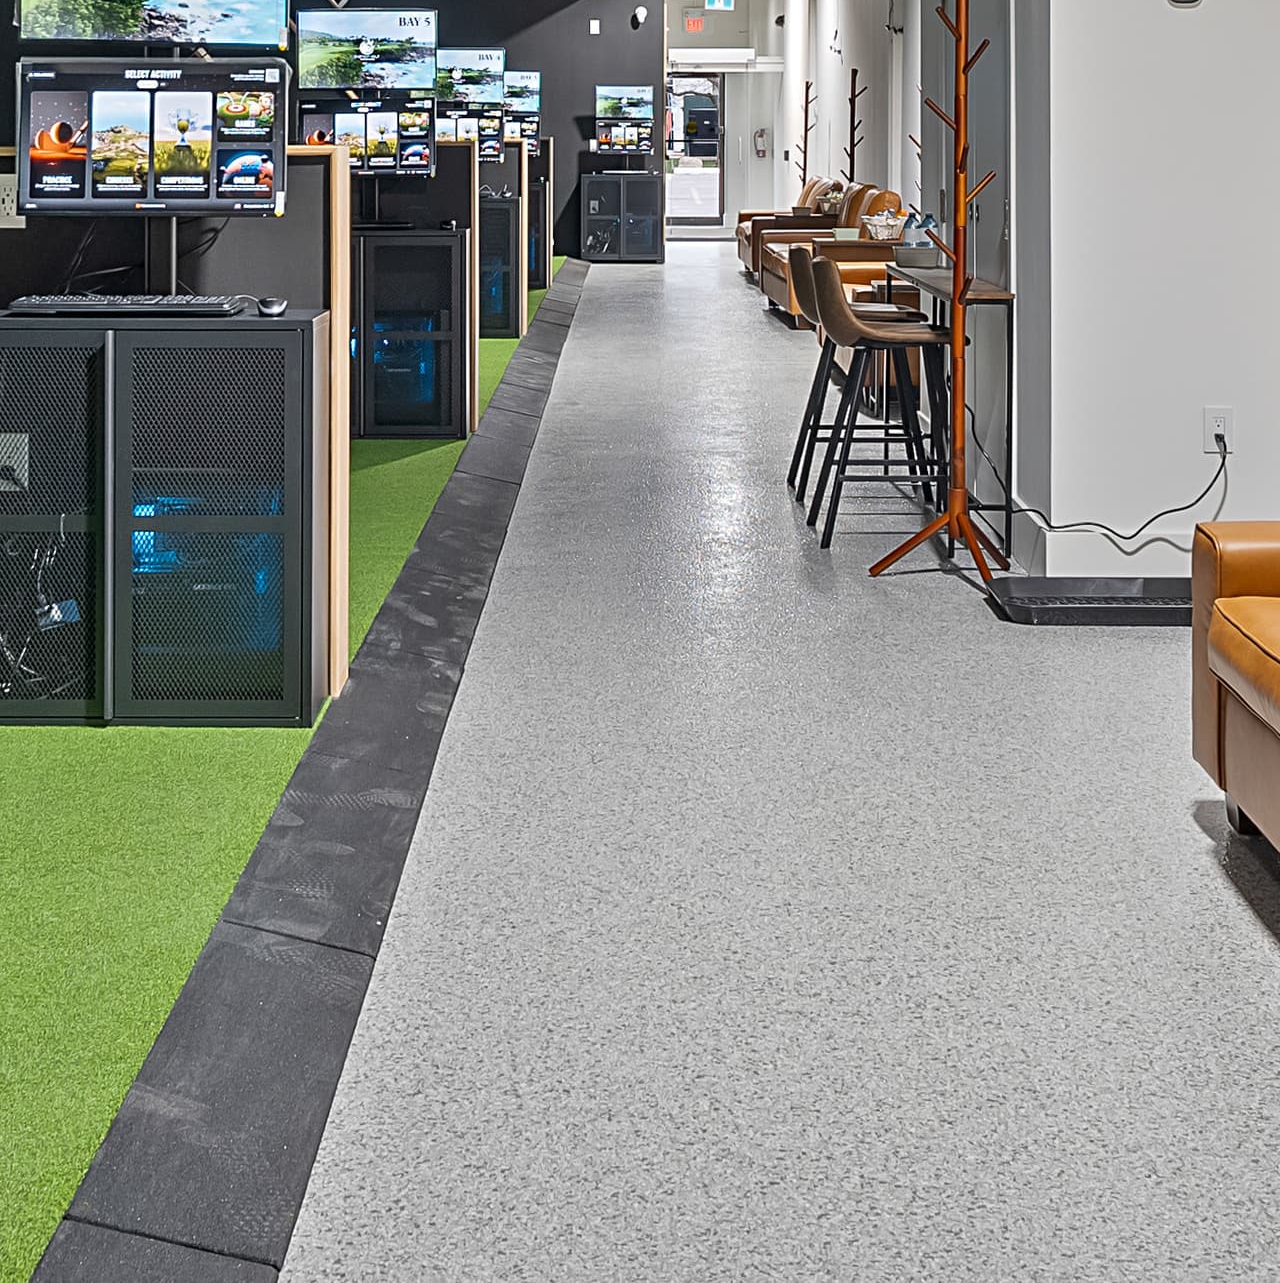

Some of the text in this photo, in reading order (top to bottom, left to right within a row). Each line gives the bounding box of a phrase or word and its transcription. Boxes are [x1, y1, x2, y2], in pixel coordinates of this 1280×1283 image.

[399, 16, 431, 27] BAY 5
[124, 69, 182, 79] SELECT ACTIVITY
